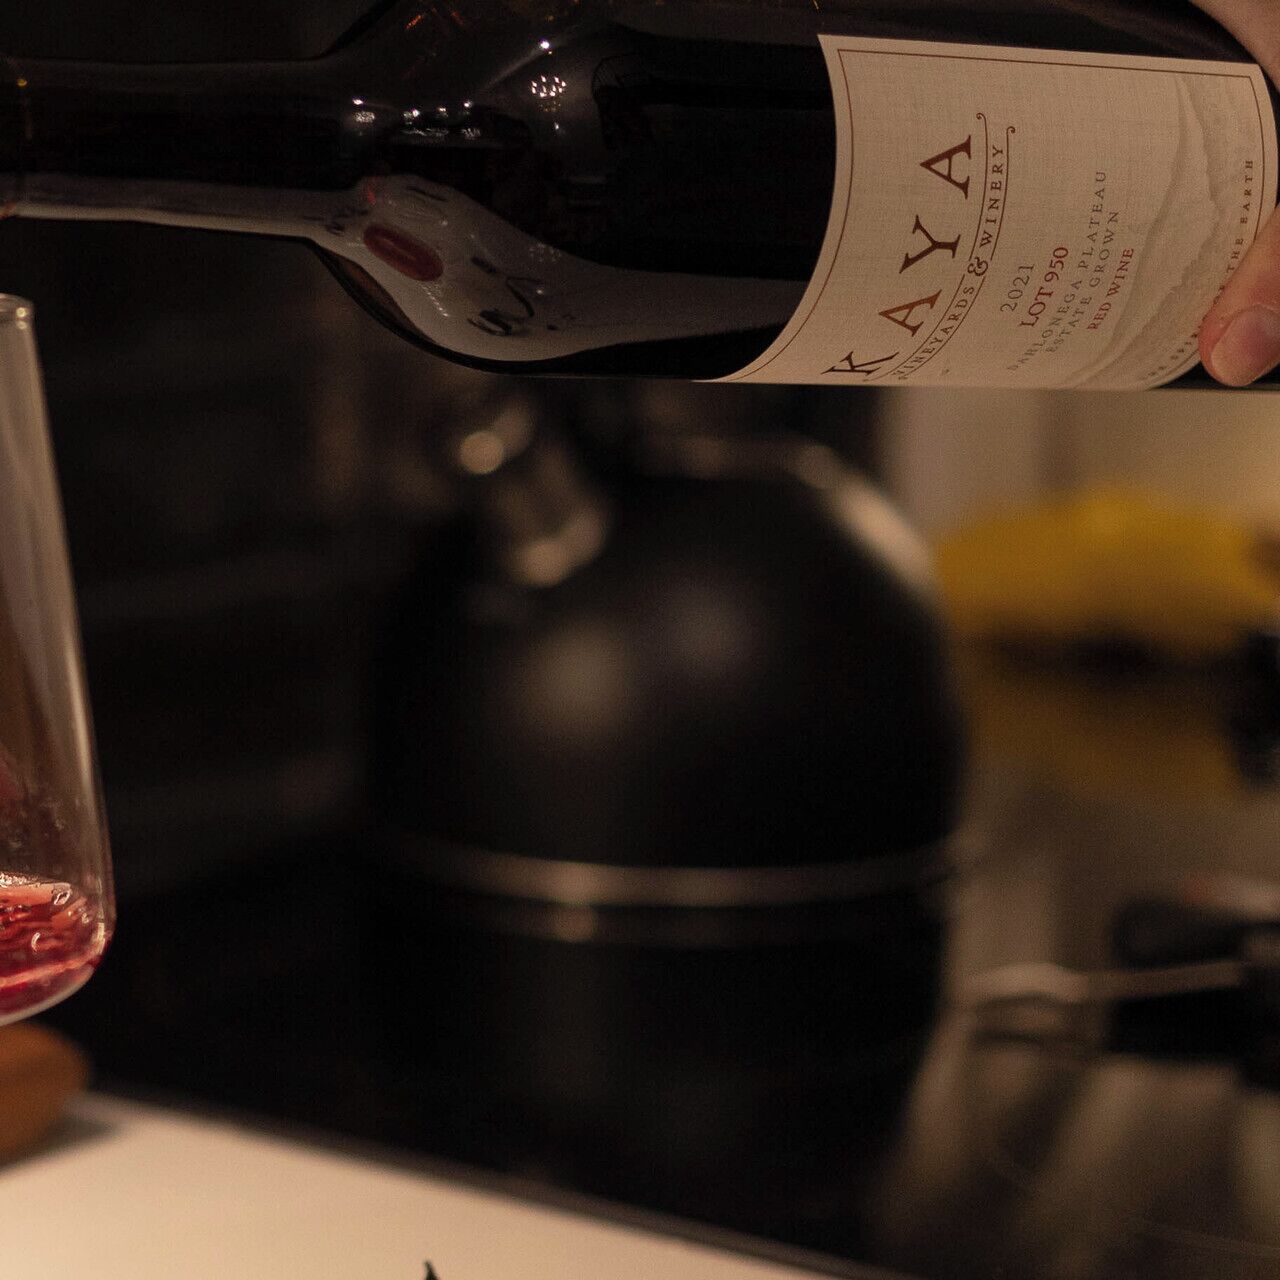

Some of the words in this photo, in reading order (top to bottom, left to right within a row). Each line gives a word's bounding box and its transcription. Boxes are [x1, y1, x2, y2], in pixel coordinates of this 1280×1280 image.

[821, 134, 971, 376] KAYA
[891, 286, 975, 377] VINEYARDS
[967, 256, 989, 277] &
[980, 144, 1004, 248] WINERY
[1078, 171, 1106, 269] PLATEAU
[1226, 238, 1244, 273] THE
[1240, 160, 1253, 224] EARTH
[1000, 263, 1035, 312] 2021
[1020, 286, 1054, 327] LOT
[1044, 246, 1068, 282] 950
[1046, 295, 1092, 353] ESTATE
[1089, 211, 1120, 288] GROWN
[1086, 302, 1112, 330] RED
[1106, 247, 1134, 297] WINE
